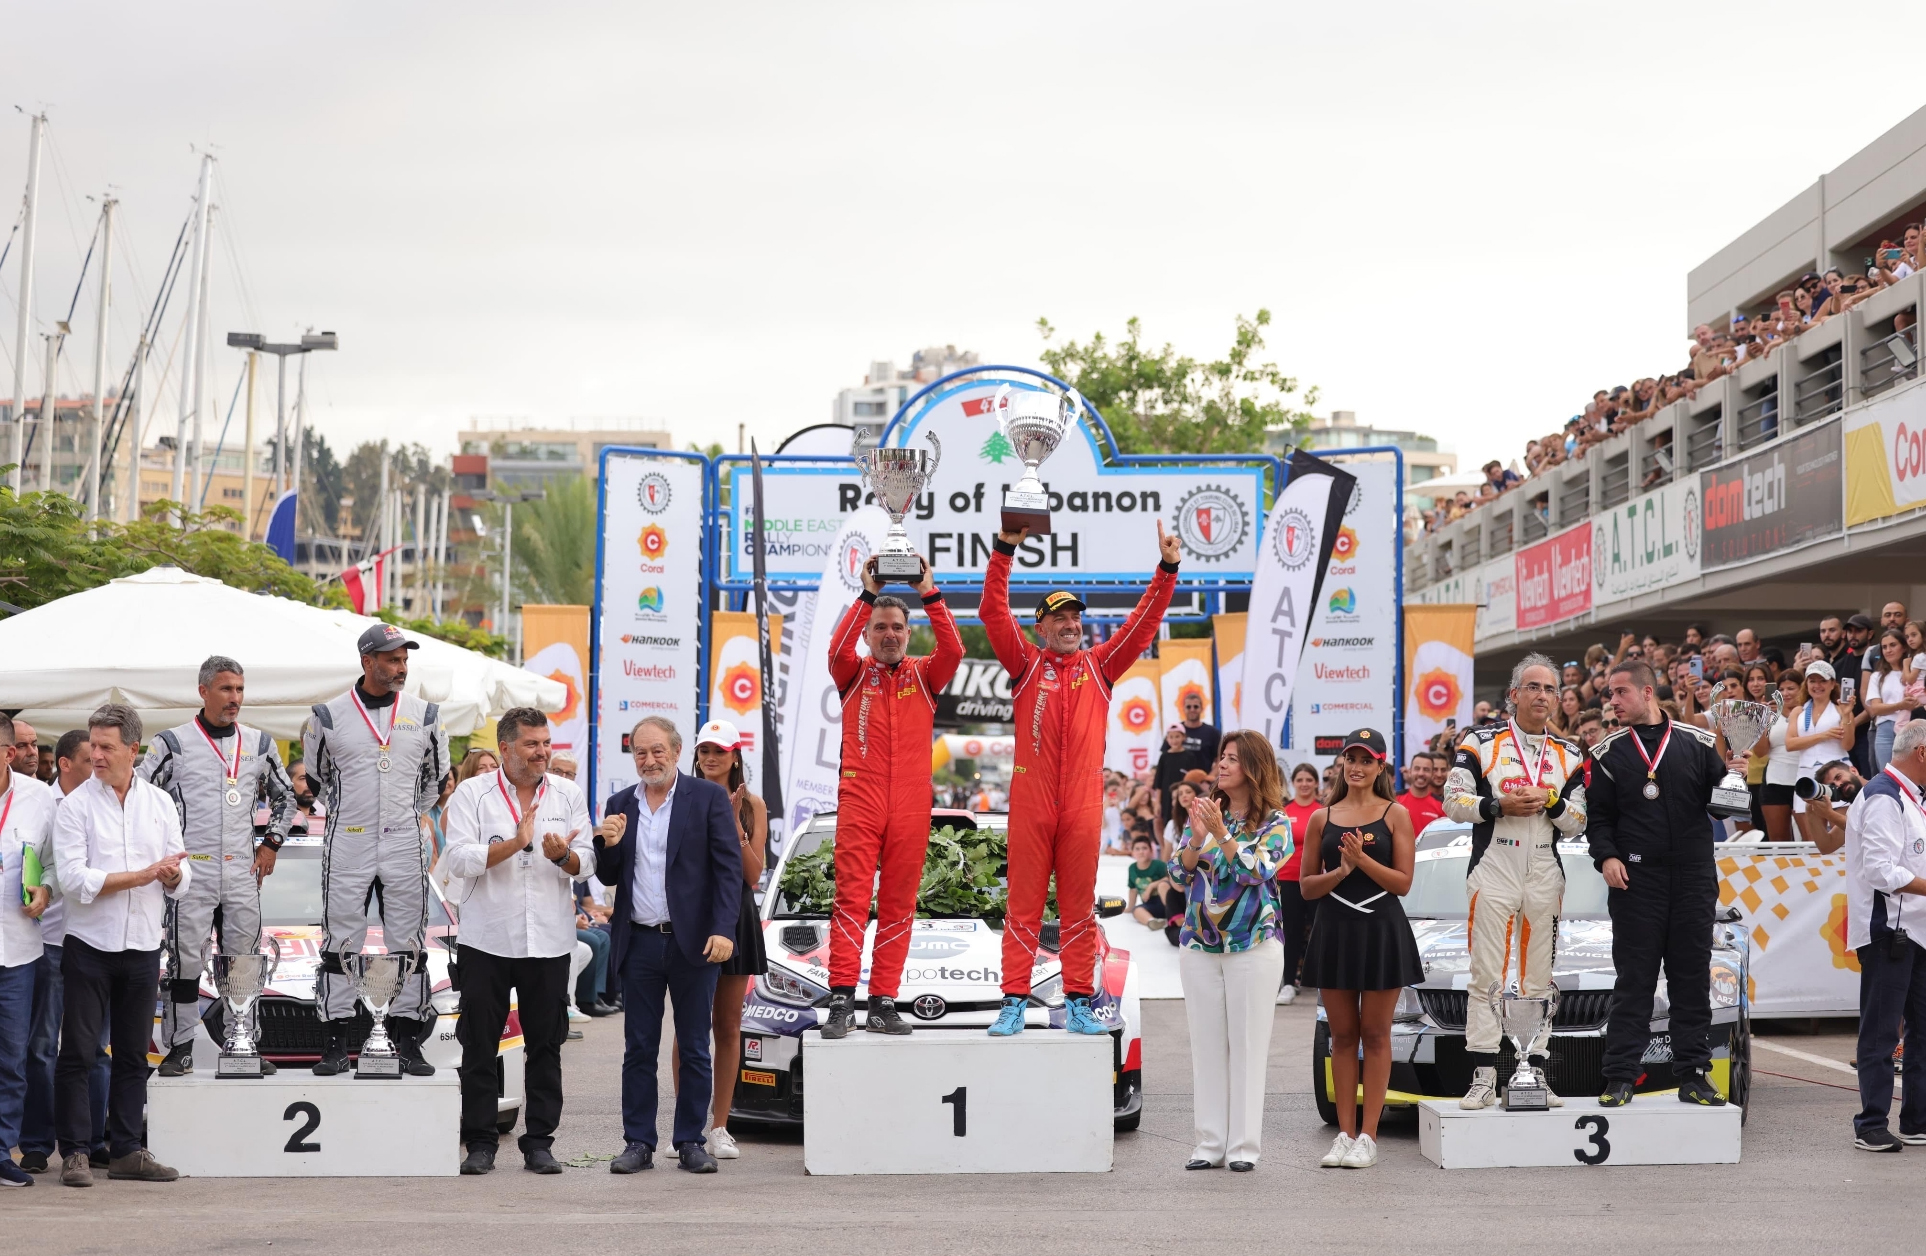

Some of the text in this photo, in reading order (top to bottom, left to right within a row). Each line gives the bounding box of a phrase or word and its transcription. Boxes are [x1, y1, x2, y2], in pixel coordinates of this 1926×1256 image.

[949, 482, 985, 513] of
[1002, 482, 1161, 512] banon
[1704, 452, 1786, 531] domtech
[744, 519, 803, 532] MDDLE
[1611, 491, 1679, 575] A.T.C.L.
[929, 532, 1079, 568] FINSH
[640, 563, 665, 574] Coral
[1330, 566, 1356, 576] Coral
[623, 659, 676, 679] Viewtech
[1314, 663, 1370, 680] Viewtech
[630, 700, 679, 710] COMMERCIAL
[956, 701, 1013, 721] driving
[1322, 702, 1374, 711] COMMERCIAL
[796, 778, 834, 797] MEMBER
[1716, 994, 1734, 1006] ARZ
[744, 1071, 774, 1084] PIRELLI
[941, 1086, 967, 1137] 1
[283, 1101, 322, 1153] 2
[1574, 1114, 1611, 1165] 3
